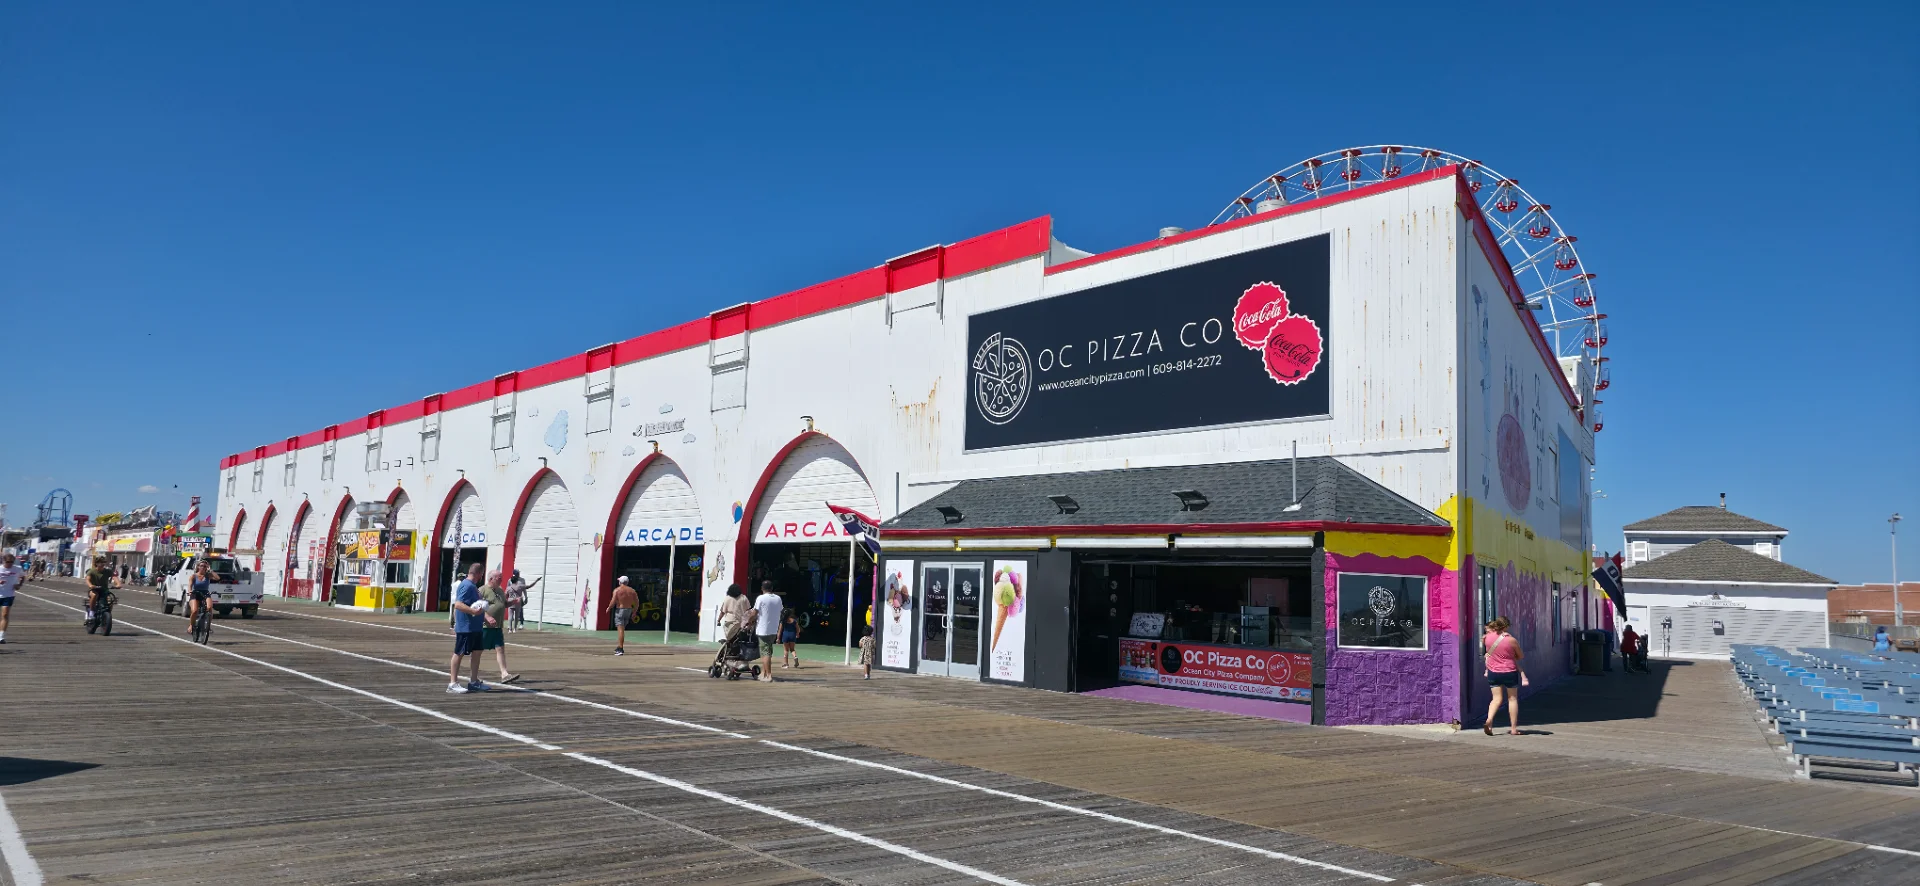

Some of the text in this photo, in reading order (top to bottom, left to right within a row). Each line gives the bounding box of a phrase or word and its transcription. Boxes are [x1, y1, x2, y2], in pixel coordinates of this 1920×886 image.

[1038, 317, 1223, 372] OC PIZZA CO
[1038, 367, 1145, 392] www.oceancitypizza.com
[1153, 354, 1222, 375] 609-814-2272
[624, 526, 704, 542] ARCADE
[1183, 649, 1204, 665] OC
[1208, 651, 1242, 668] Pizza
[1245, 654, 1265, 670] Co
[1183, 666, 1265, 682] Ocean City Pizza Company
[1175, 678, 1201, 687] PROUDLY
[1202, 680, 1227, 690] SERVING
